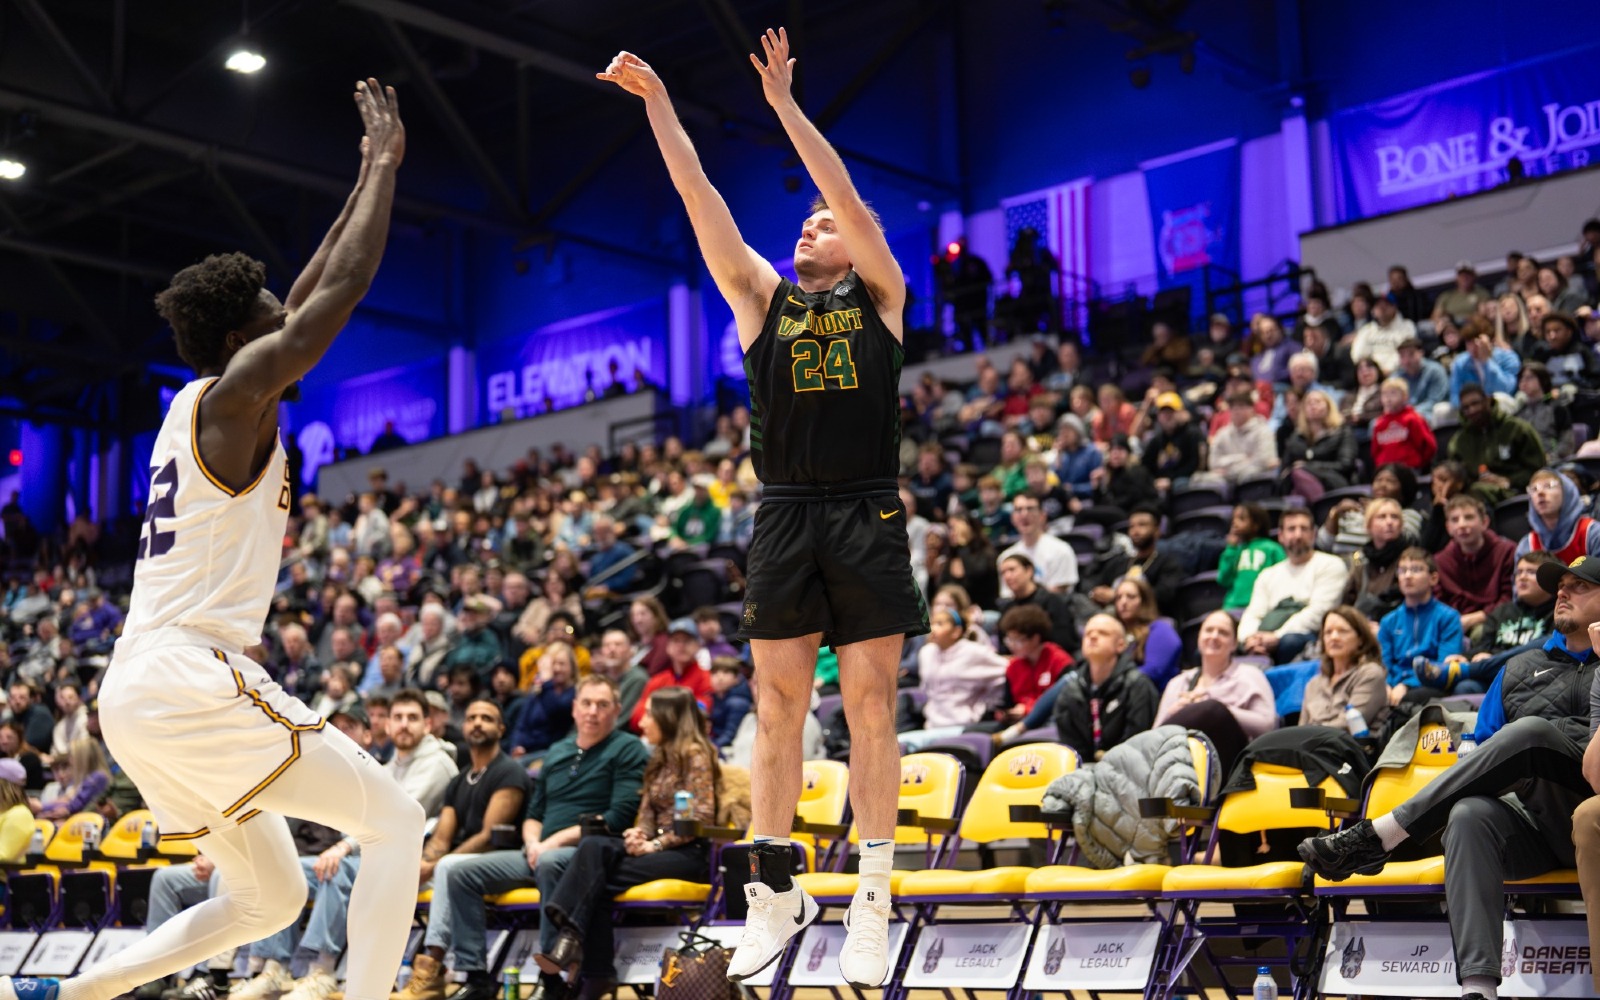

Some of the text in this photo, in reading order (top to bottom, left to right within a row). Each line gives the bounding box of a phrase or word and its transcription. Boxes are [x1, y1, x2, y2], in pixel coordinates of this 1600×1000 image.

[1377, 102, 1600, 186] BONE & JOI
[791, 339, 859, 392] 24
[1237, 548, 1266, 571] AP
[968, 944, 998, 954] JACK
[1093, 943, 1125, 954] JACK
[1411, 945, 1429, 957] JP
[1522, 946, 1590, 960] DANES
[955, 957, 1003, 968] LEGAULT
[1080, 957, 1131, 969] LEGAULT
[1381, 961, 1453, 974] SEWARD II
[1521, 961, 1593, 975] GREAT
